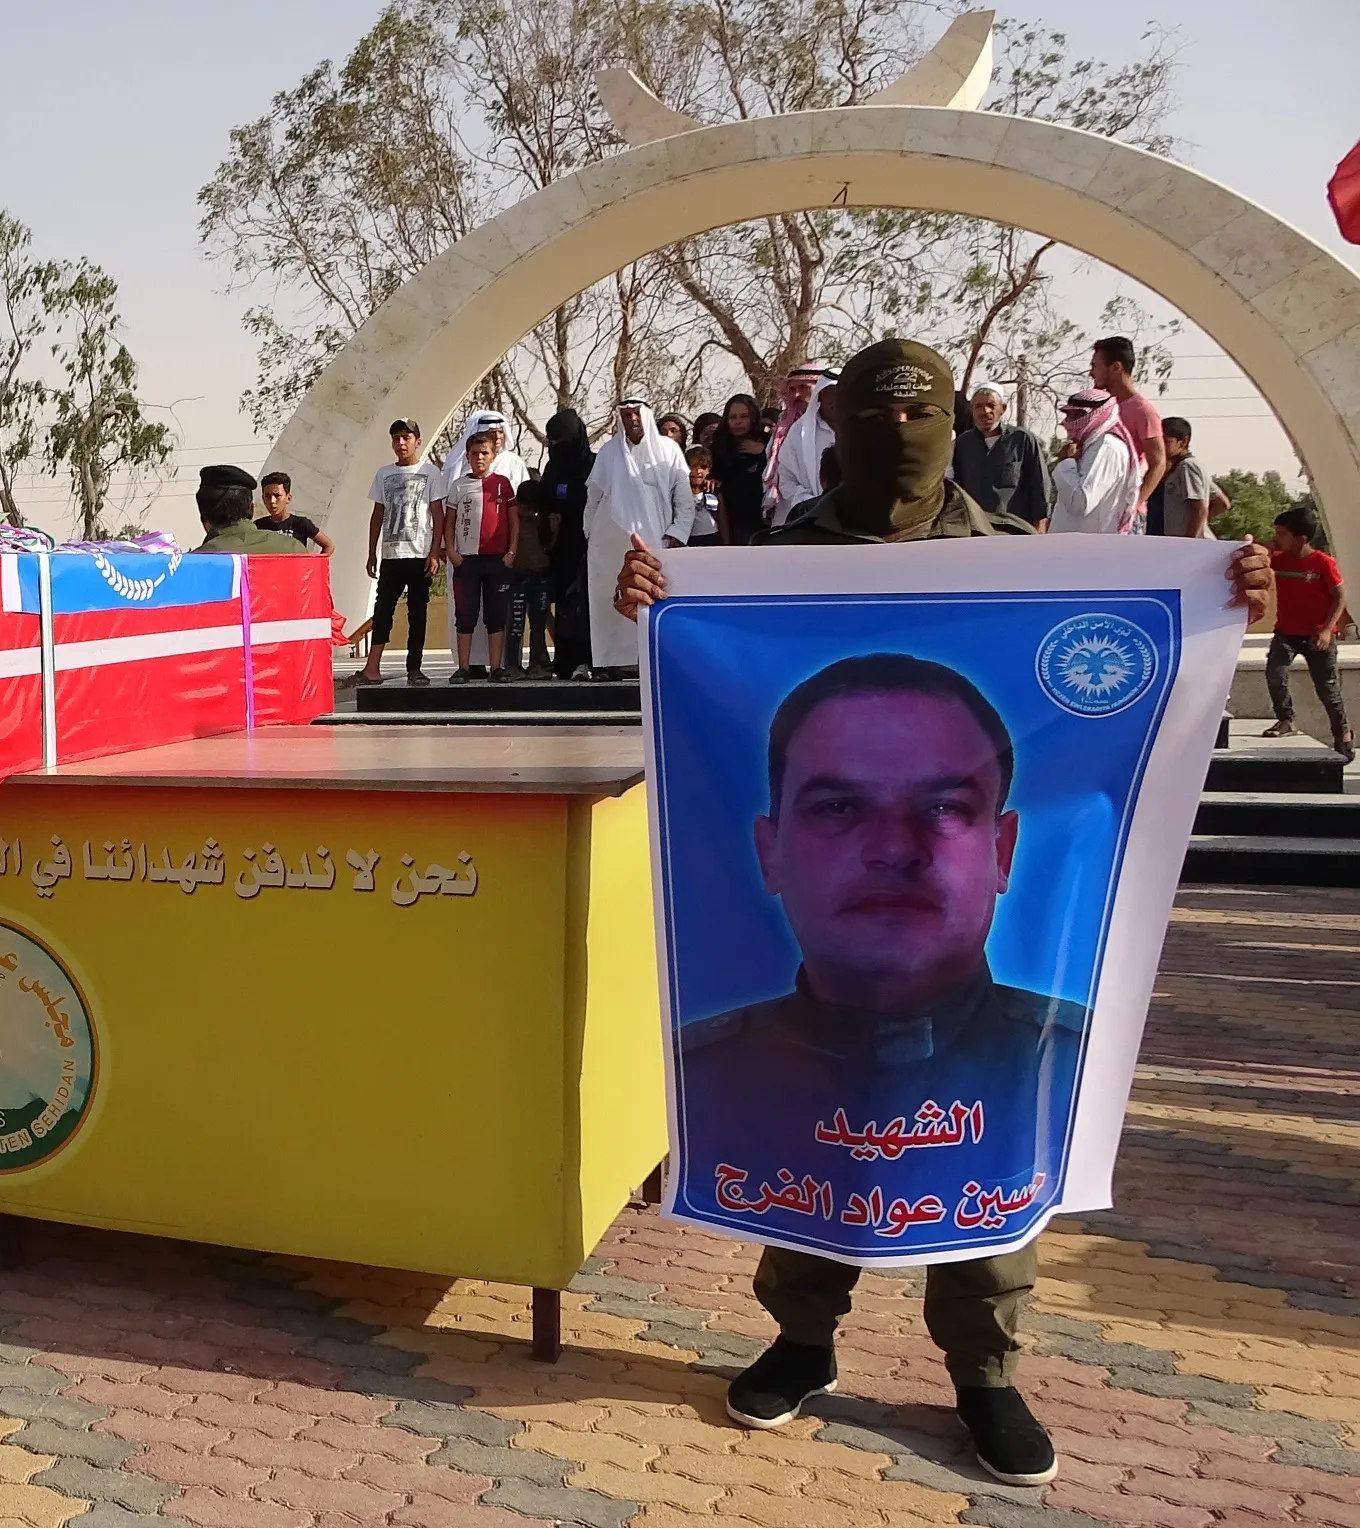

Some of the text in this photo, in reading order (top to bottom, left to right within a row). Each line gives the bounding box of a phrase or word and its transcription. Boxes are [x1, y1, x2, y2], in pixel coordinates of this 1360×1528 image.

[31, 834, 72, 898] في
[82, 837, 225, 893] شهدائنا
[234, 841, 335, 898] ندفن
[346, 848, 380, 891] لا
[391, 850, 478, 906] نحن
[18, 975, 75, 1048] مجلس
[33, 1059, 75, 1135] SEHIDAN
[814, 1100, 984, 1160] الشهيد
[714, 1163, 1046, 1236] سين عواد الفرج
